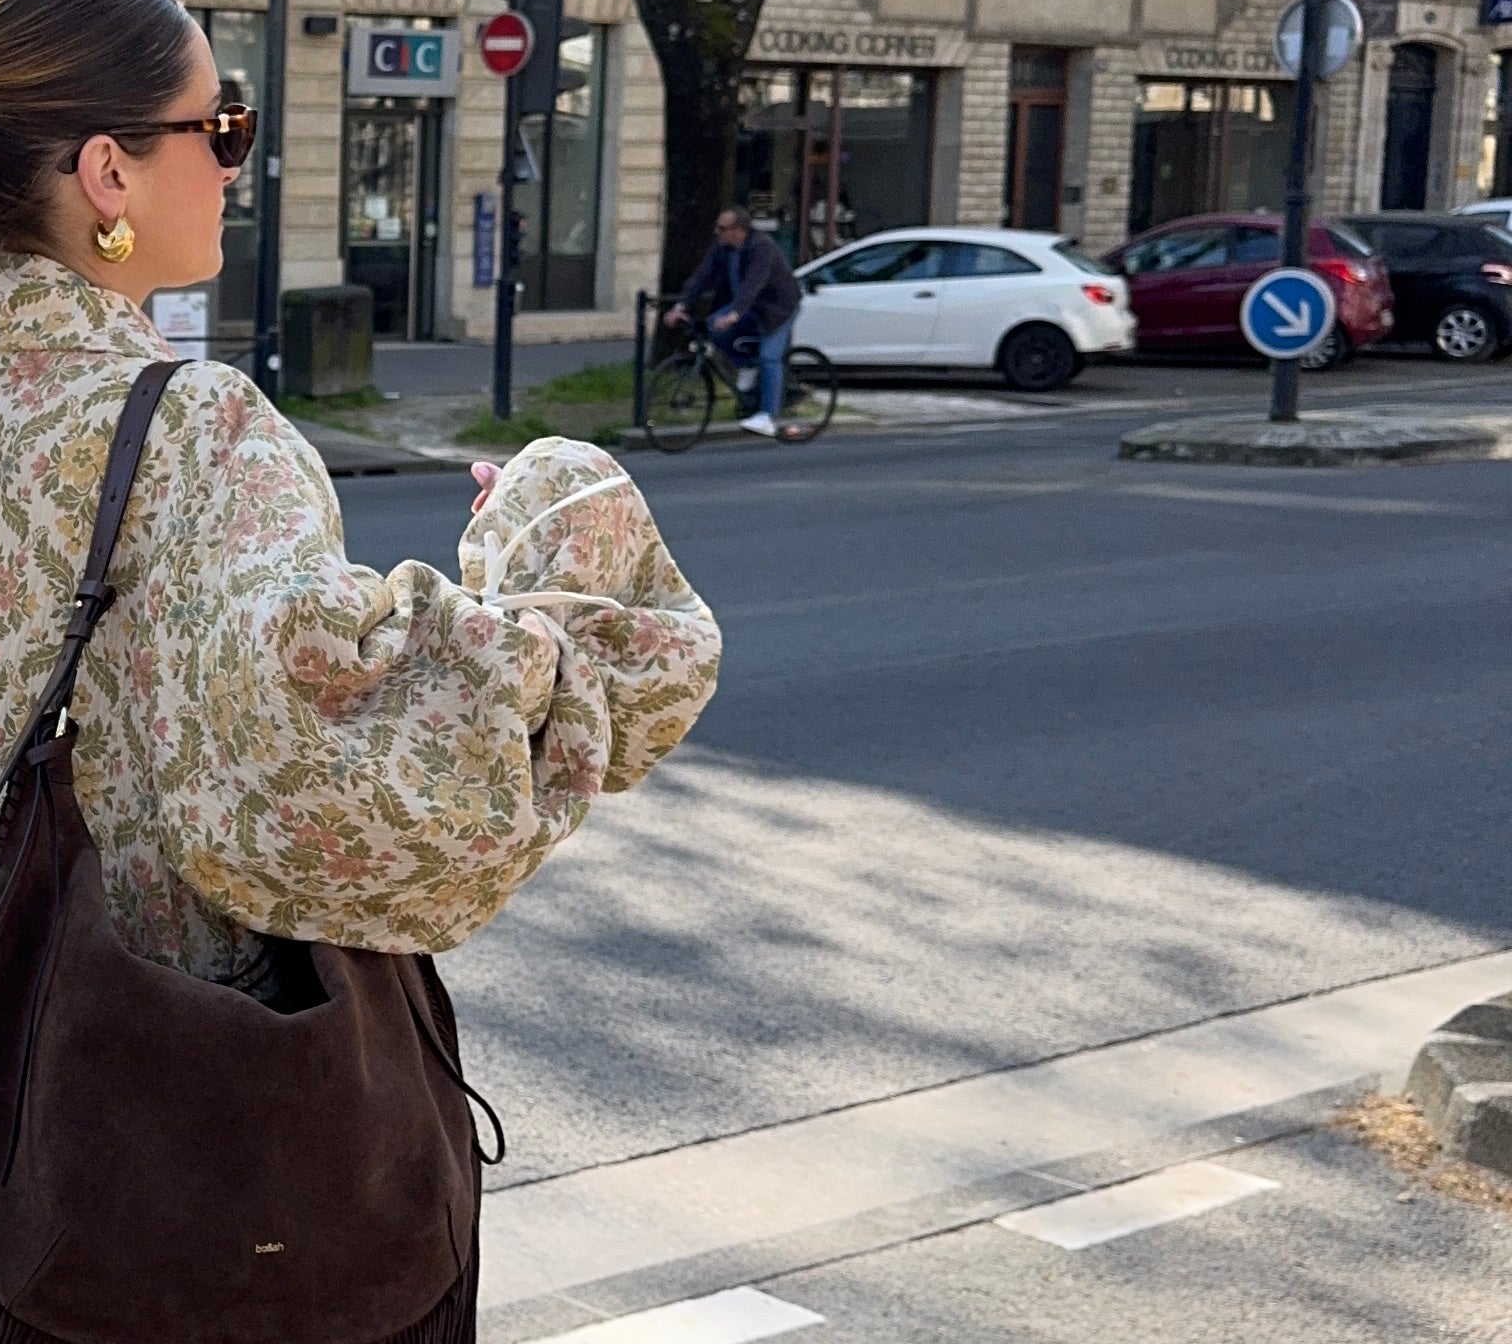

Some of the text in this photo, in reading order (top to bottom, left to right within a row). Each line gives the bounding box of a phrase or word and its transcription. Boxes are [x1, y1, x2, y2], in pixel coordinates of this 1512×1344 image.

[374, 40, 438, 74] CIC
[759, 29, 936, 58] COOKING CORNER
